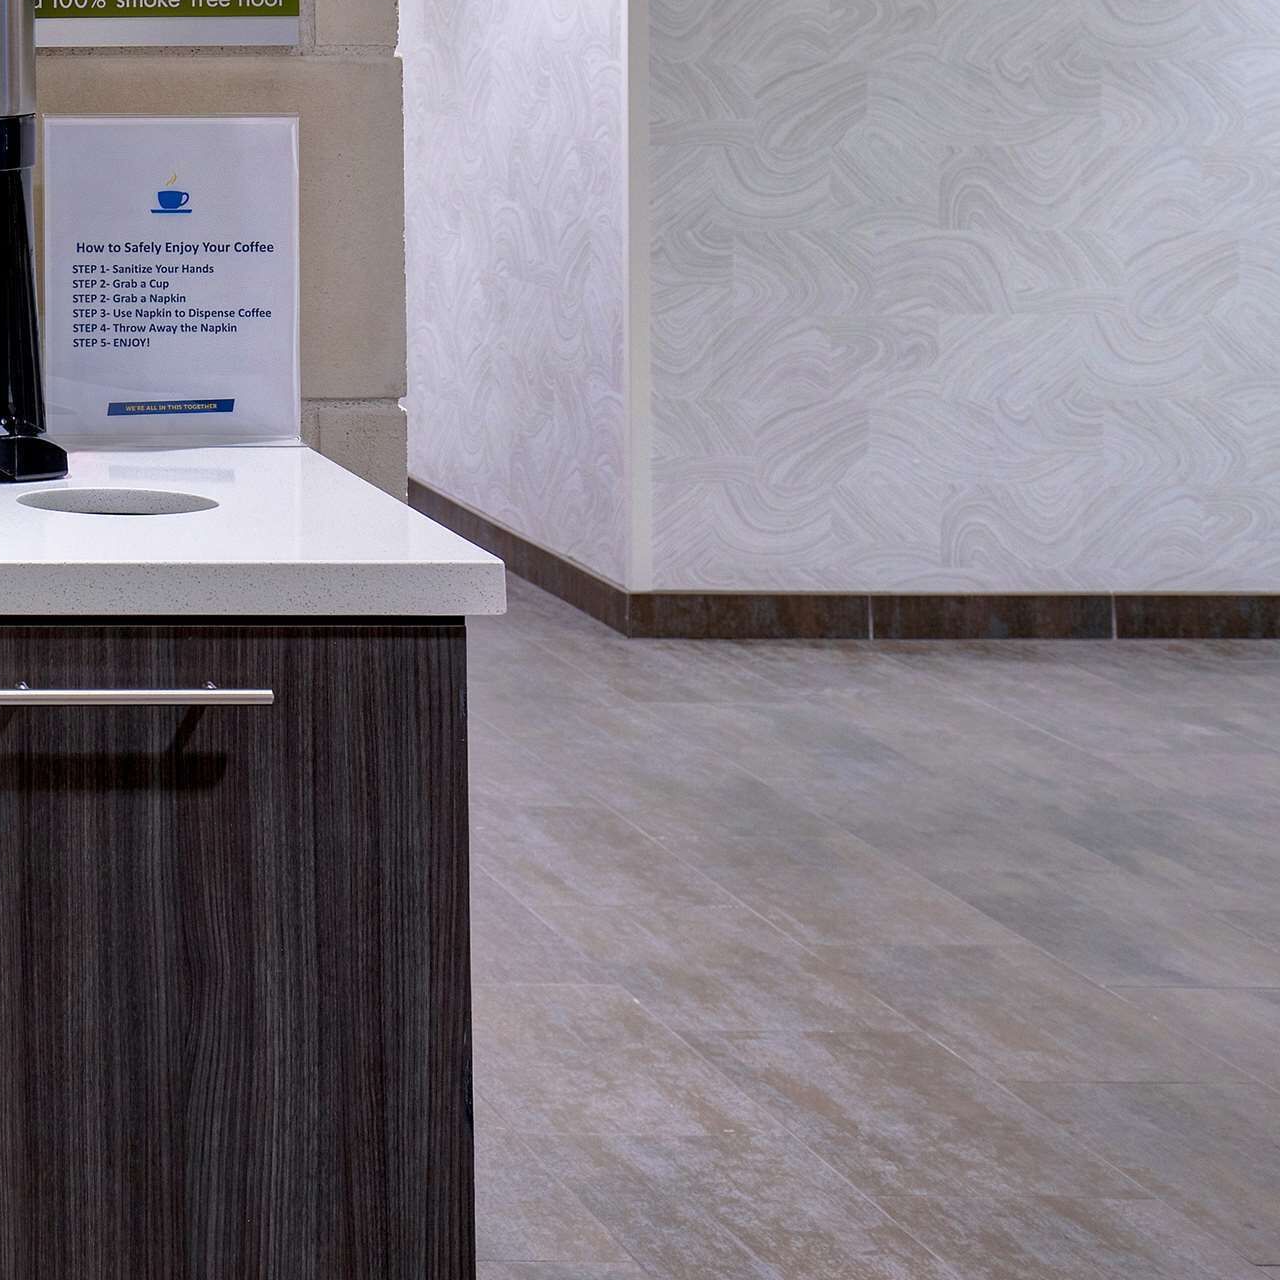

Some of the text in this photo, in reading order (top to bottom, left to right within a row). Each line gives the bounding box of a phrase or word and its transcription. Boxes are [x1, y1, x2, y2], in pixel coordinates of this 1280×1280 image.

[76, 241, 274, 256] How to Safely Enjoy Your Coffee
[72, 264, 214, 274] STEP 1- Sanitize Your Hands
[72, 279, 97, 288] STEP
[100, 279, 110, 288] 2-
[113, 279, 138, 289] Grab
[149, 279, 169, 291] Cup
[72, 294, 97, 303] STEP
[100, 294, 110, 303] 2-
[113, 294, 138, 303] Grab
[149, 294, 186, 306] Napkin
[72, 308, 272, 320] STEP 3- Use Napkin to Dispense Coffee
[72, 322, 238, 335] STEP 4- Throw Away the Napkin
[72, 338, 150, 348] STEP 5- ENJOY!
